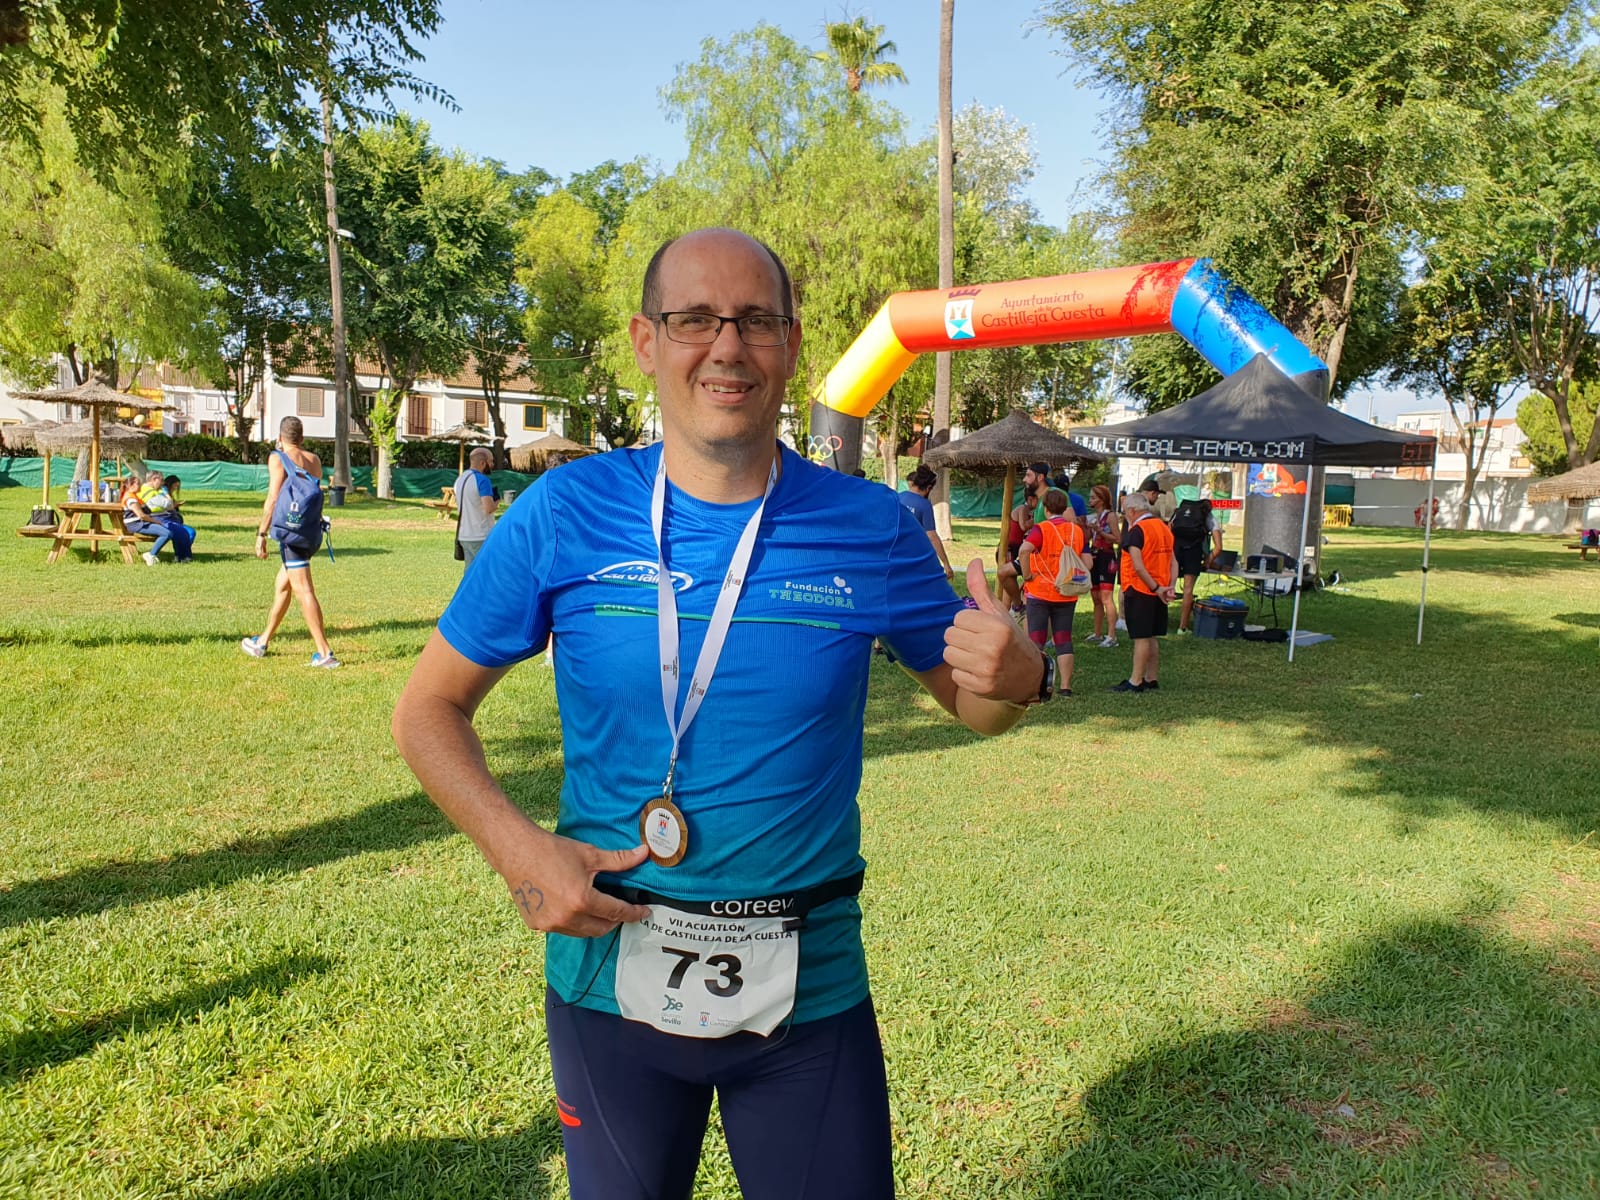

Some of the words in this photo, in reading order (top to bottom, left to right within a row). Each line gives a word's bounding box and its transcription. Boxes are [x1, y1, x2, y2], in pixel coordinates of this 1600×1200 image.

[1000, 290, 1084, 310] Ayuntamiento
[981, 309, 1048, 327] Castilleja
[1051, 304, 1106, 322] Cuesta
[785, 581, 841, 595] Fundación
[769, 588, 856, 609] THEODORA
[710, 897, 796, 915] coreev
[651, 923, 664, 934] DE
[664, 928, 722, 942] CASTILLEJA
[755, 931, 793, 941] CUESTA
[669, 916, 684, 928] VII
[685, 921, 746, 933] ACUATLÓN
[661, 945, 744, 998] 73
